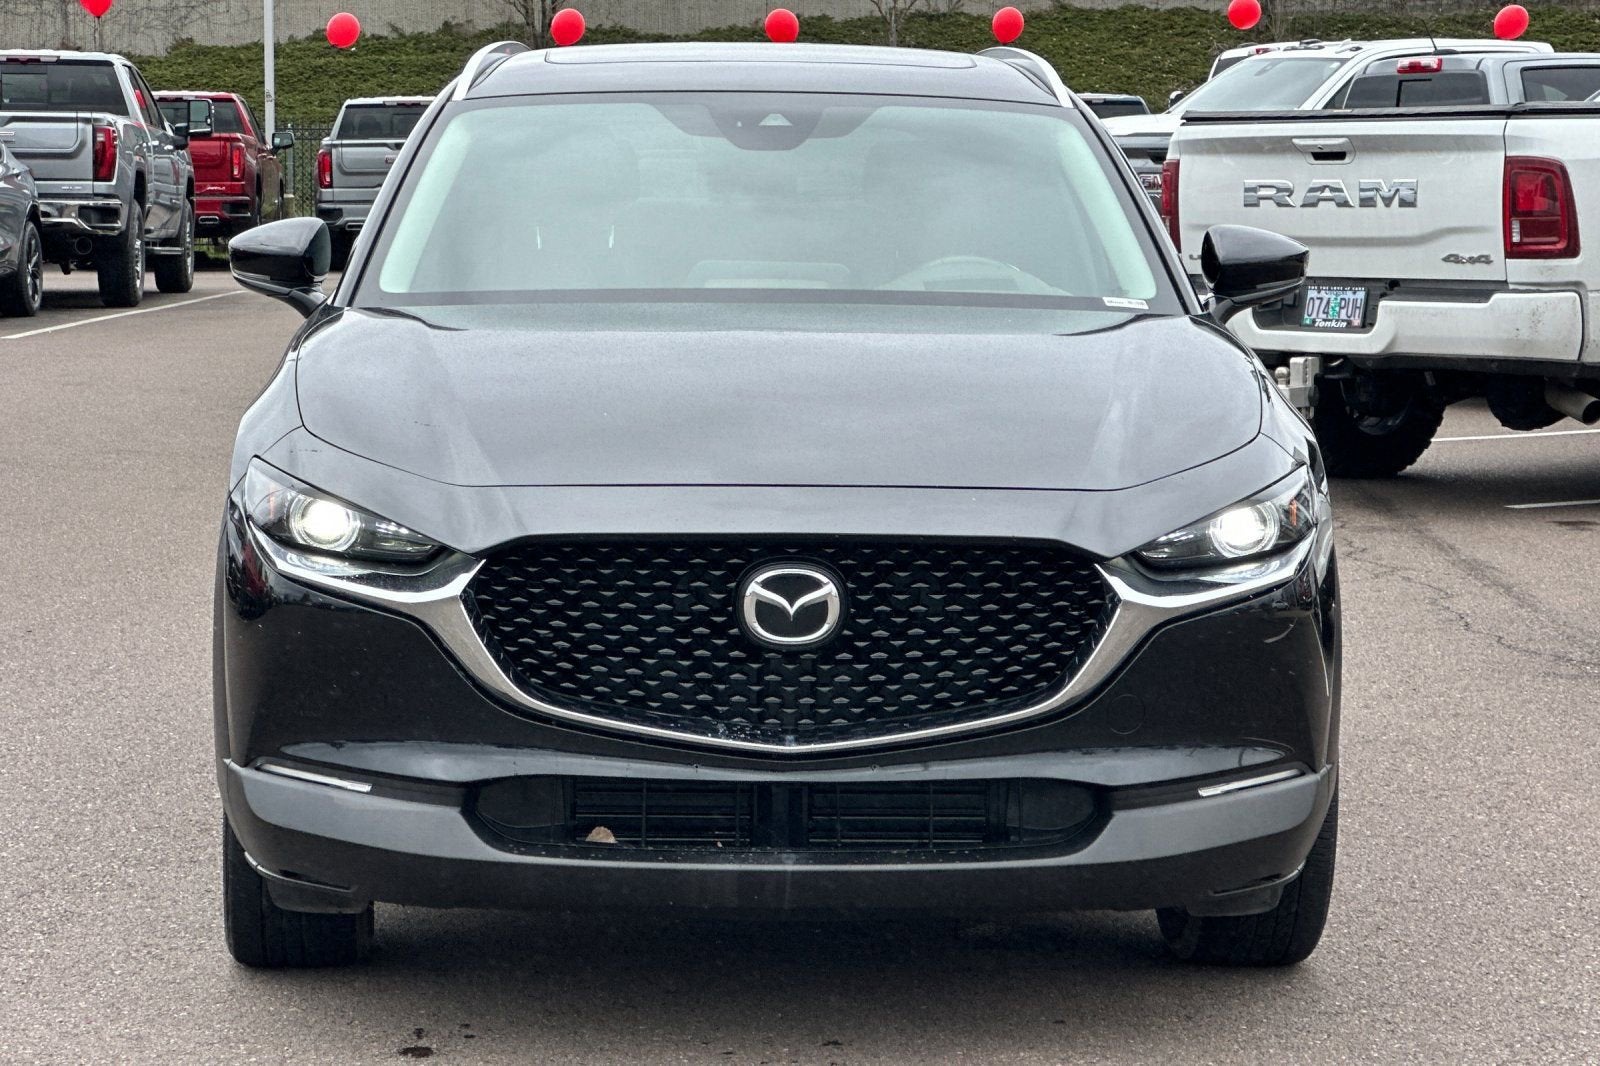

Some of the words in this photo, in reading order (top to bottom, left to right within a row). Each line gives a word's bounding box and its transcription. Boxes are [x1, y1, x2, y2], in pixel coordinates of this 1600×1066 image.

[1243, 178, 1418, 208] RAM
[1338, 297, 1363, 319] PUH
[1314, 318, 1347, 328] Tonkin
